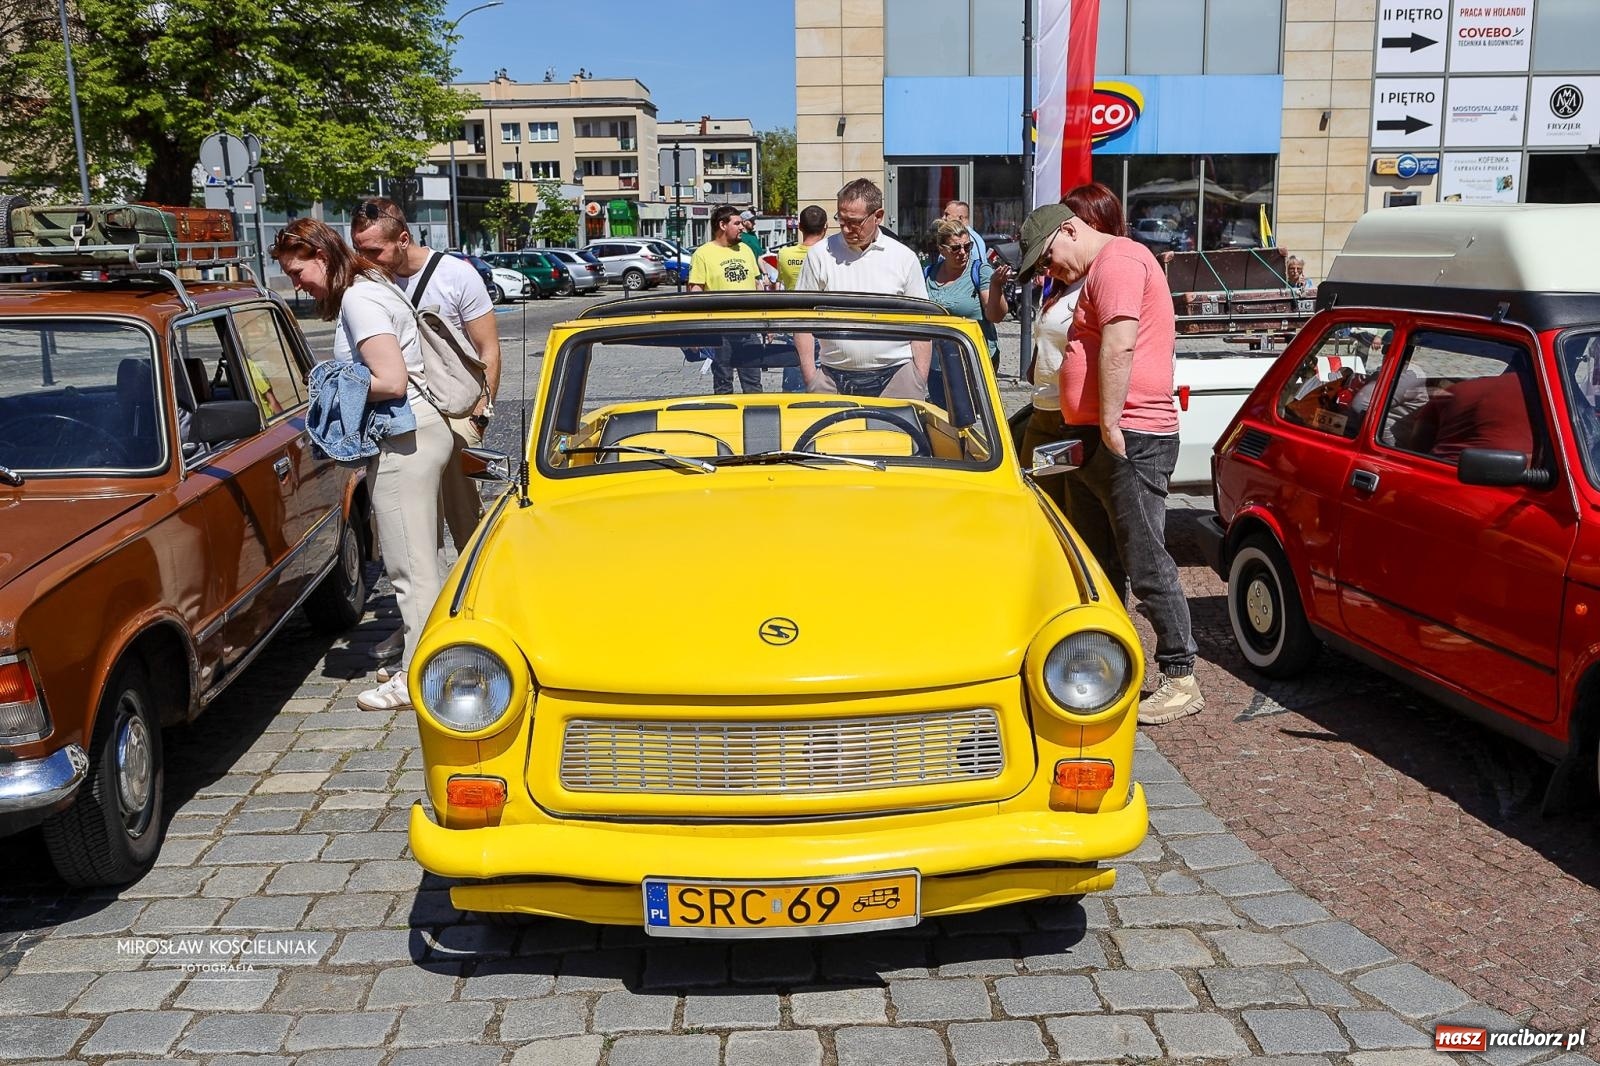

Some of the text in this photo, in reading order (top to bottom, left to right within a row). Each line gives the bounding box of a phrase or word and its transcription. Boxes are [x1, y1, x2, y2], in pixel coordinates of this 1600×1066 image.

[1383, 8, 1443, 23] II PIĘTRO
[1460, 7, 1526, 17] PRACA W HOLANDII
[1459, 27, 1512, 38] COVEBO
[1487, 39, 1524, 47] BUDOWNICTWO
[1380, 91, 1435, 106] I PIĘTRO
[1547, 122, 1581, 131] FRYZJER
[1478, 156, 1510, 164] KOFEINKA
[677, 886, 841, 925] SRC 69
[651, 908, 667, 919] PL
